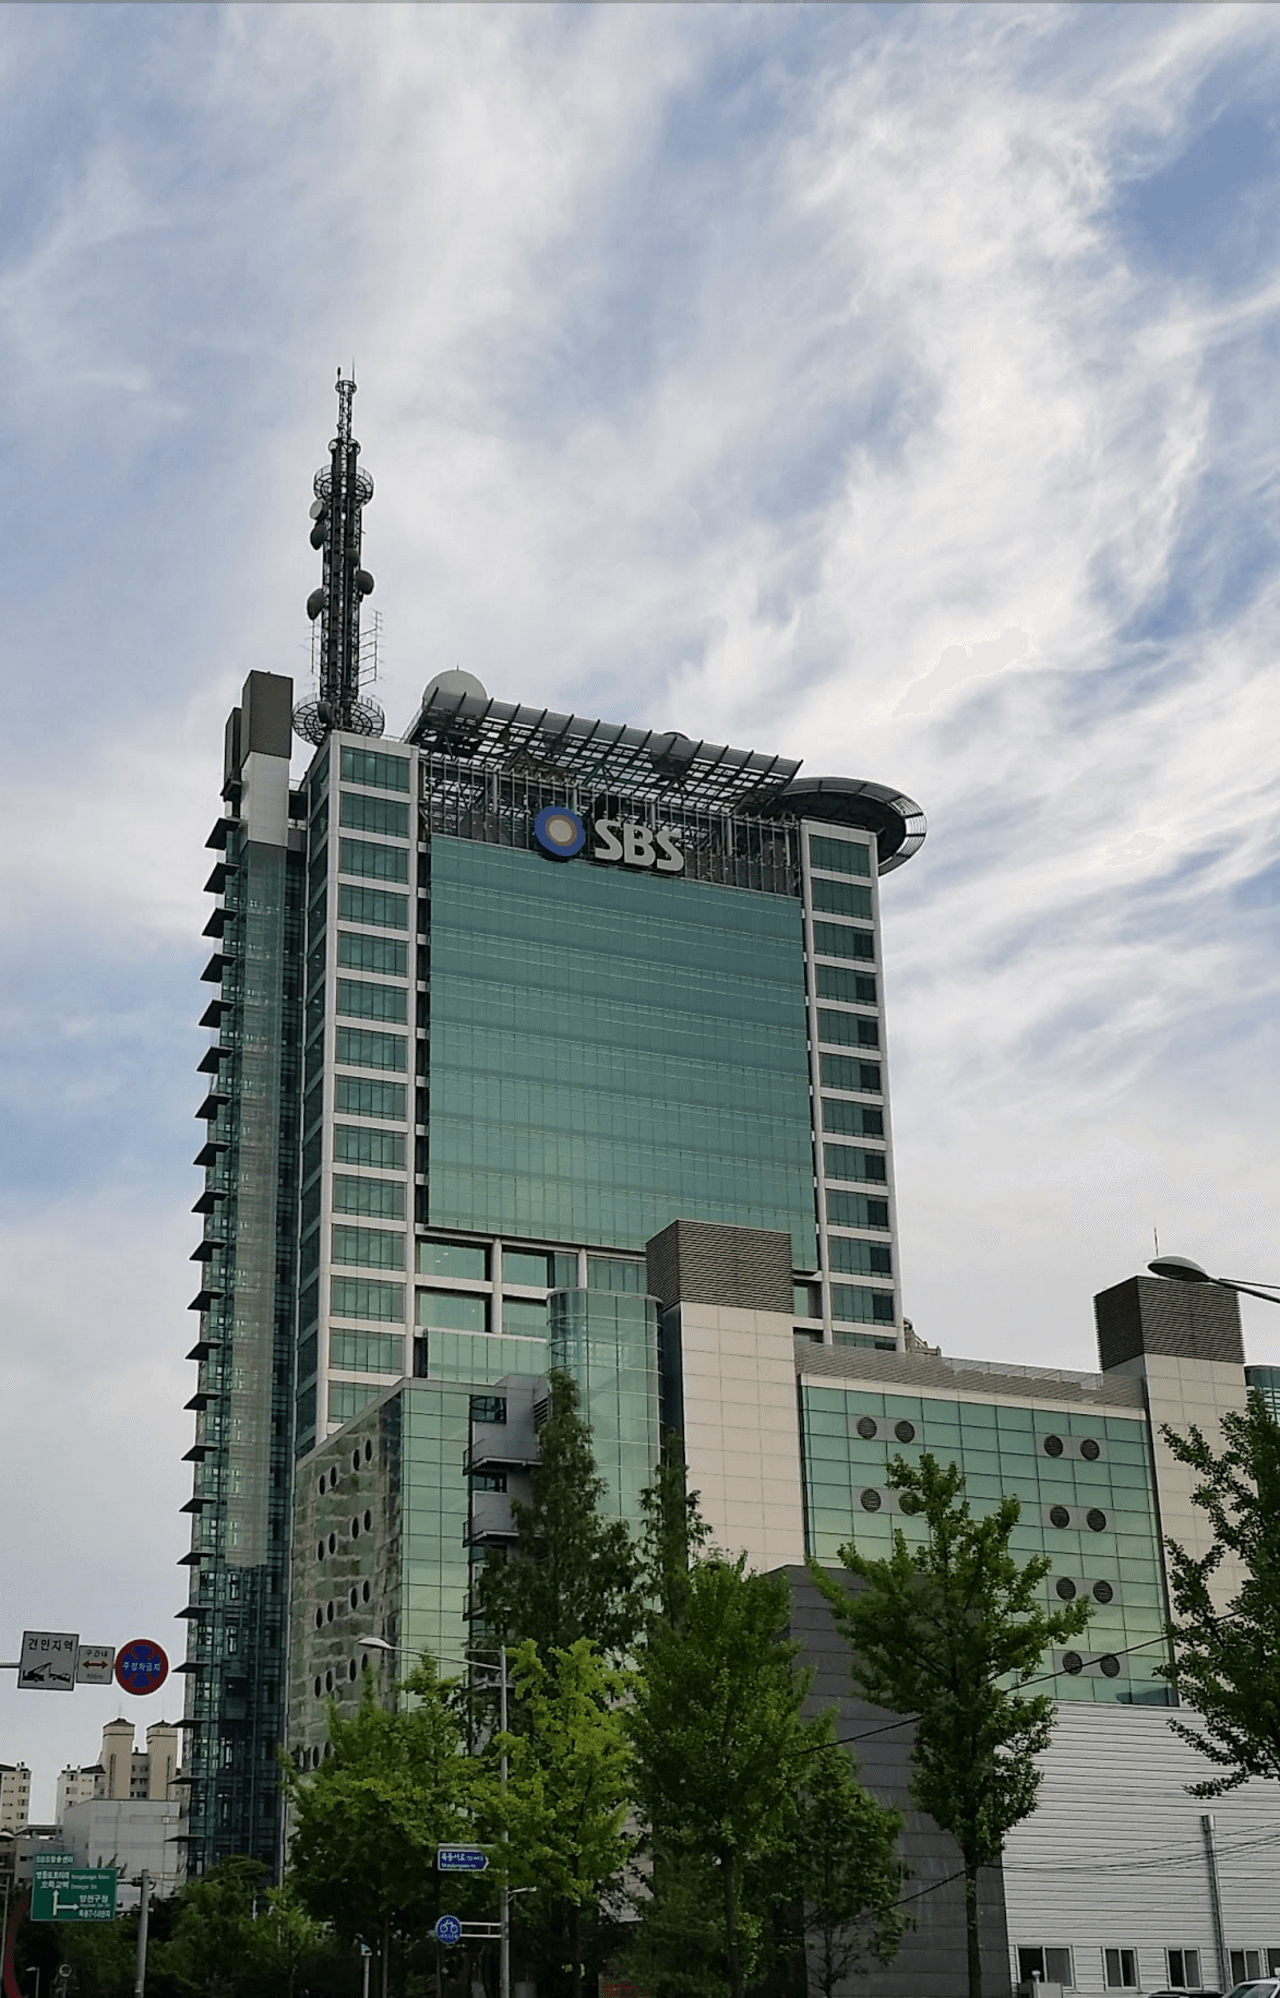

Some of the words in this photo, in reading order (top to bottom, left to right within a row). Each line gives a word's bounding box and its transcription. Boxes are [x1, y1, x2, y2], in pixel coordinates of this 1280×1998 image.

[595, 819, 684, 871] SBS
[28, 1638, 73, 1652] 견인지역
[86, 1649, 108, 1658] 구간내
